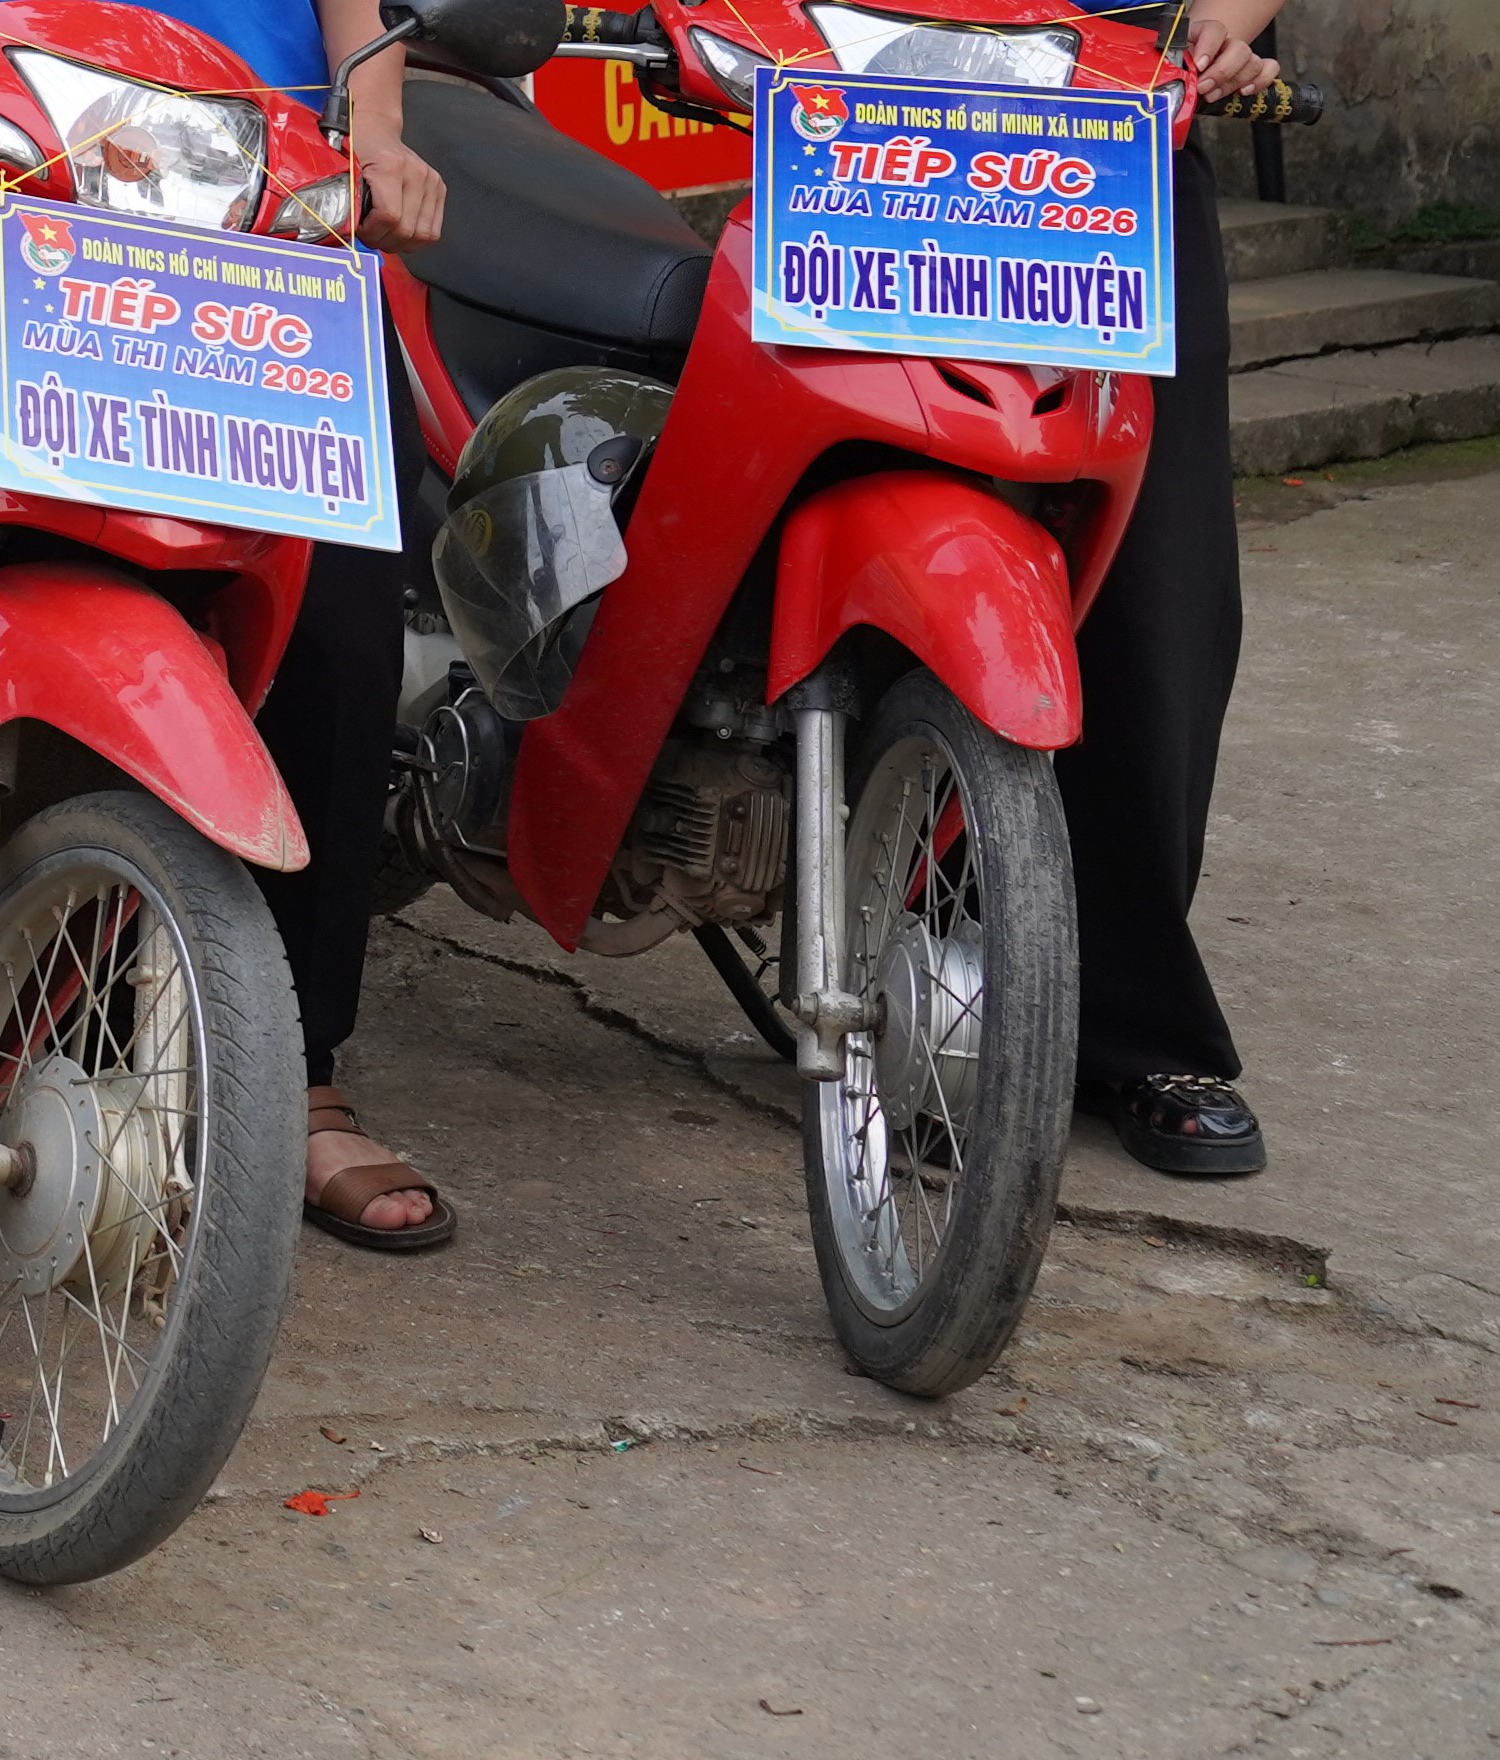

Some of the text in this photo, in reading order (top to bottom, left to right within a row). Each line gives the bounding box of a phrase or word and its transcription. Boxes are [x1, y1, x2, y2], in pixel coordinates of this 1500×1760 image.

[781, 230, 1146, 344] ĐỘI XE TÌNH NGUYỆN
